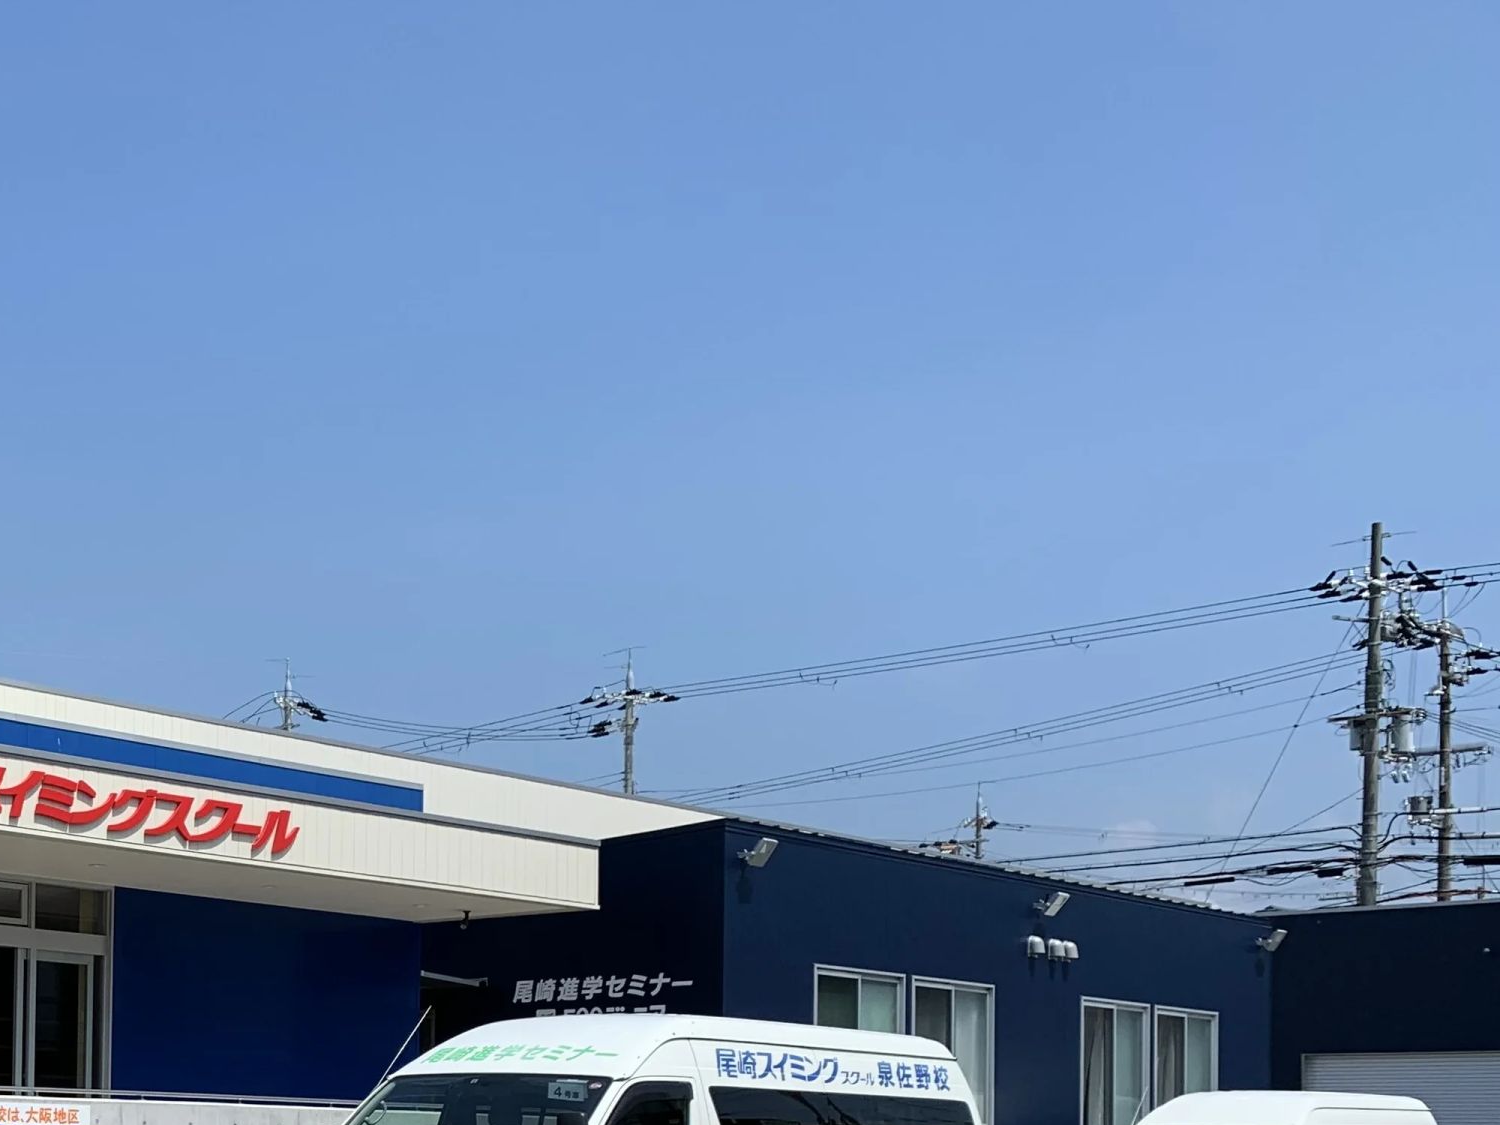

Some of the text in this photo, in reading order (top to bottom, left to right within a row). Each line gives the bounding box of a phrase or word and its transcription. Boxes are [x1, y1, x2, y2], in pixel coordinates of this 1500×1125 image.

[512, 972, 694, 1003] 尾崎進学セミナー
